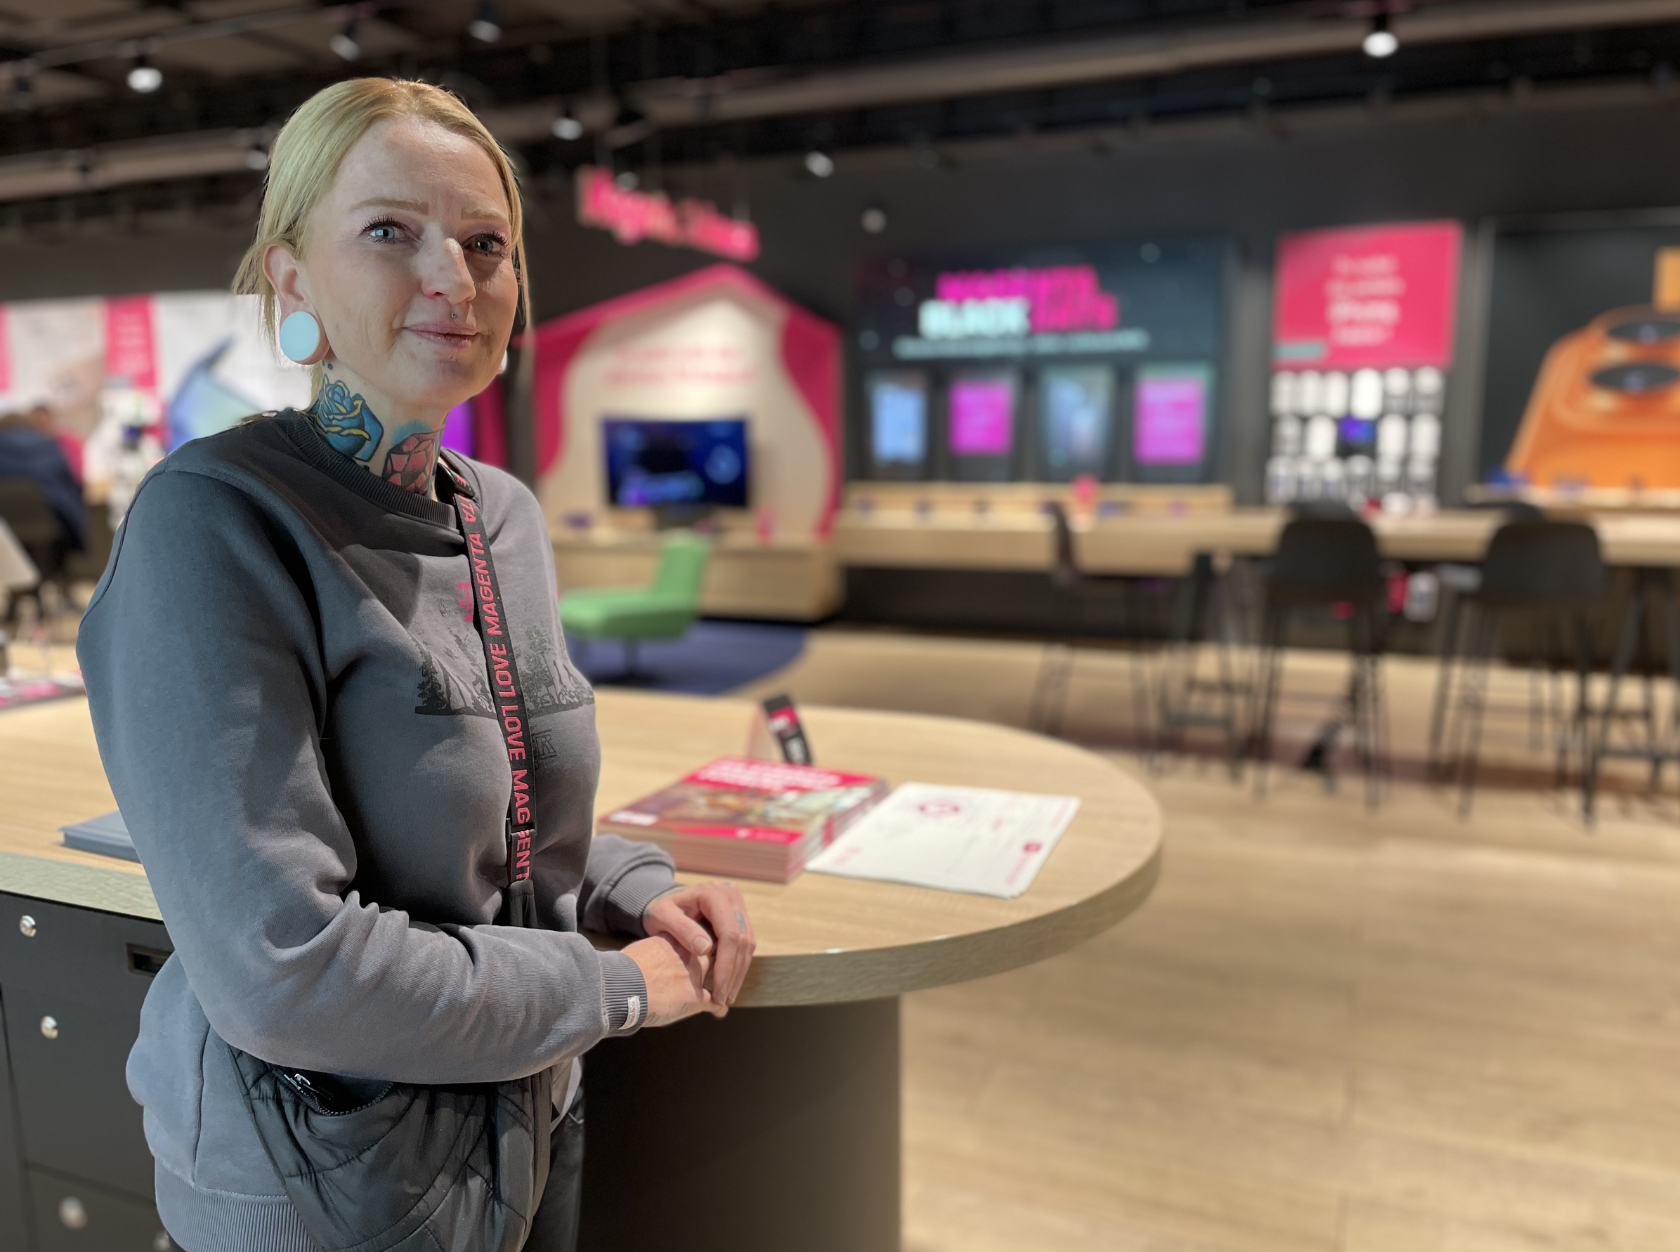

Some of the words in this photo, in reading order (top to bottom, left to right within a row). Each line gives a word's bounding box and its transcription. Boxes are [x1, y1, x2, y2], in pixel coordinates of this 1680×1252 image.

[468, 533, 503, 636] MAGENTA
[489, 643, 516, 697] LOVE
[501, 705, 526, 761] LOVE
